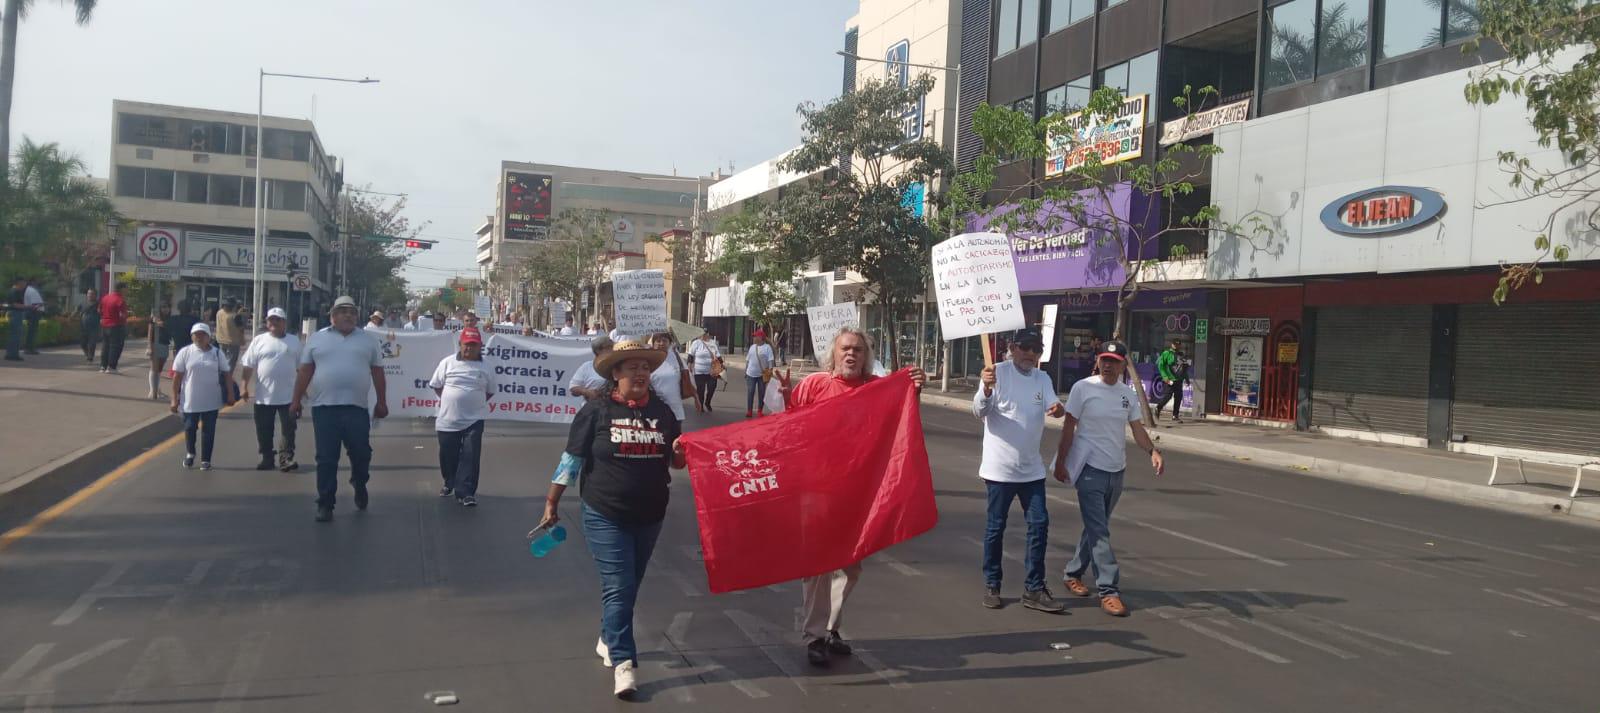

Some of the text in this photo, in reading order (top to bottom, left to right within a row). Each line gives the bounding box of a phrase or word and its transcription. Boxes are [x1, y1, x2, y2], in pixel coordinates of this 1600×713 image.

[1347, 195, 1413, 224] EL JEAN
[148, 236, 169, 252] 30
[1011, 237, 1029, 252] Ver
[936, 258, 949, 267] NO
[950, 254, 961, 262] AL
[957, 280, 970, 288] LA
[976, 275, 998, 286] UAS
[959, 306, 977, 316] PAS
[982, 304, 995, 313] DE
[555, 370, 566, 382] y
[529, 385, 549, 396] en
[552, 385, 567, 397] la
[489, 402, 497, 413] y
[499, 401, 512, 412] el
[515, 402, 542, 413] PAS
[545, 404, 562, 415] de
[564, 405, 577, 415] la
[645, 418, 658, 429] Y
[609, 426, 666, 445] SIEMPRE
[728, 474, 779, 498] CNTE
